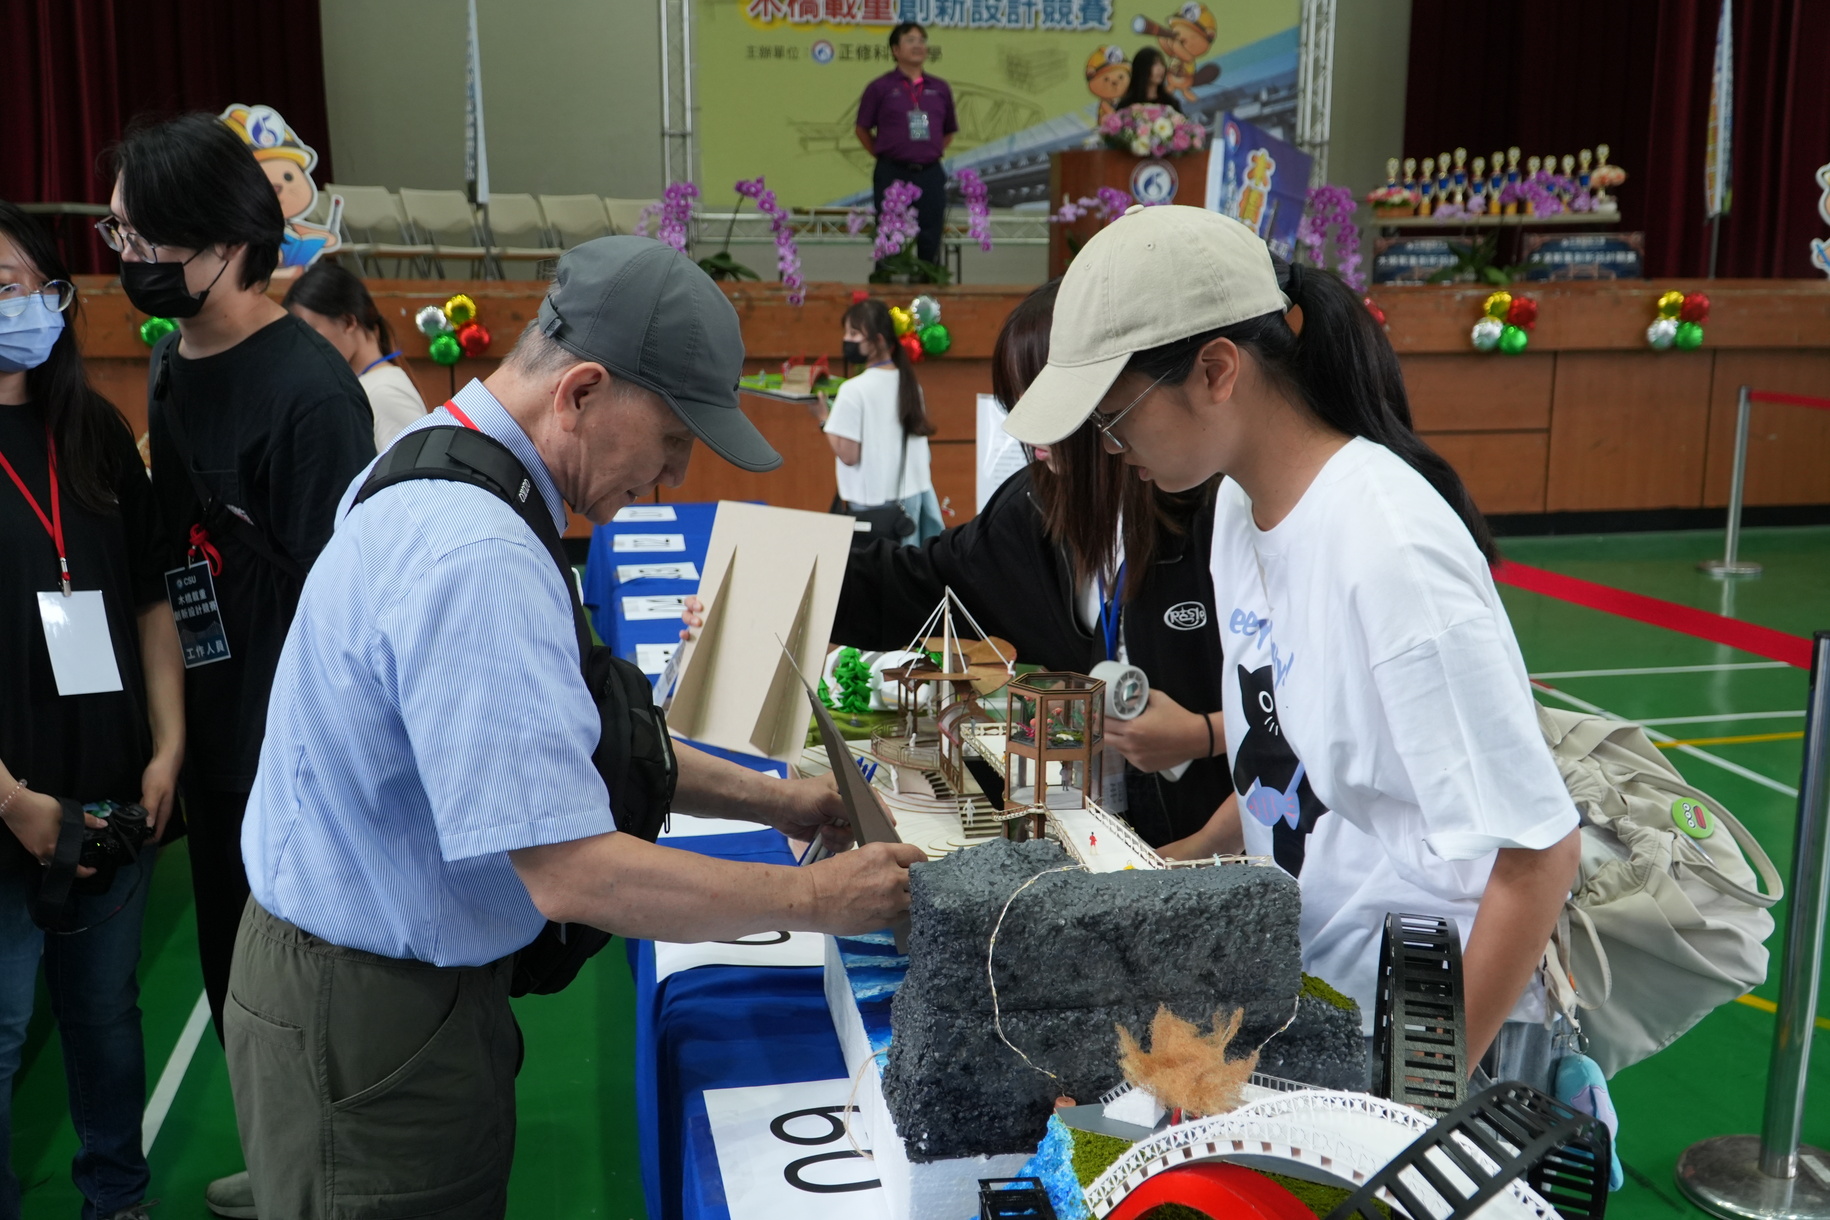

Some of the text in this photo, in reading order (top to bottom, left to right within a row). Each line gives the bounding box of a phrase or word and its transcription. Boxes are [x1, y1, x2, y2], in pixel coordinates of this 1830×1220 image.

[839, 43, 942, 62] 正修科學
[183, 575, 197, 586] CSU
[186, 639, 226, 660] 工作人員
